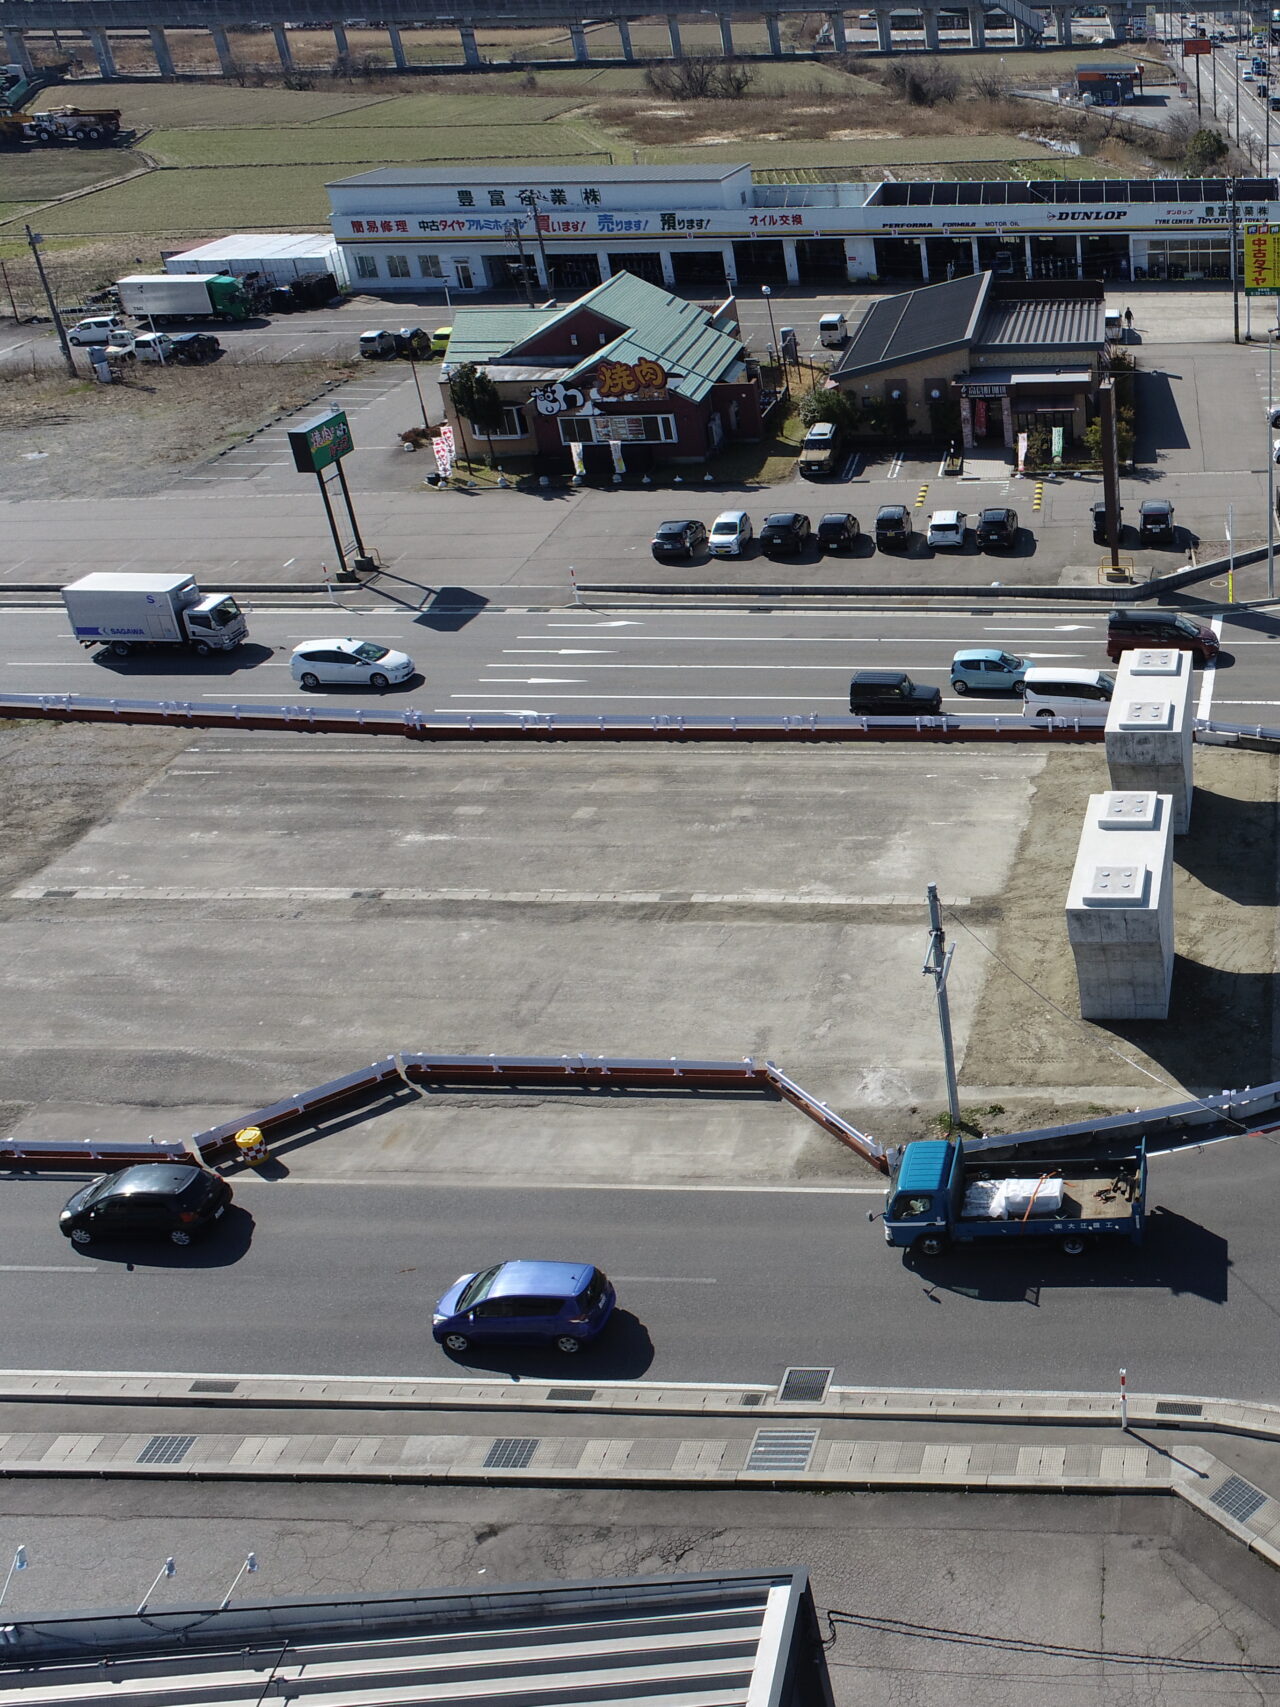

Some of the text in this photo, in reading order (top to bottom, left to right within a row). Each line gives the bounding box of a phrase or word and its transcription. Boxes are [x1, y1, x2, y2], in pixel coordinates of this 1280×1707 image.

[749, 214, 803, 226] オイル交換
[1056, 210, 1128, 221] DUNLOP
[351, 220, 409, 233] 簡易修理
[1252, 238, 1267, 286] 中古タイヤ
[599, 361, 663, 395] 焼肉
